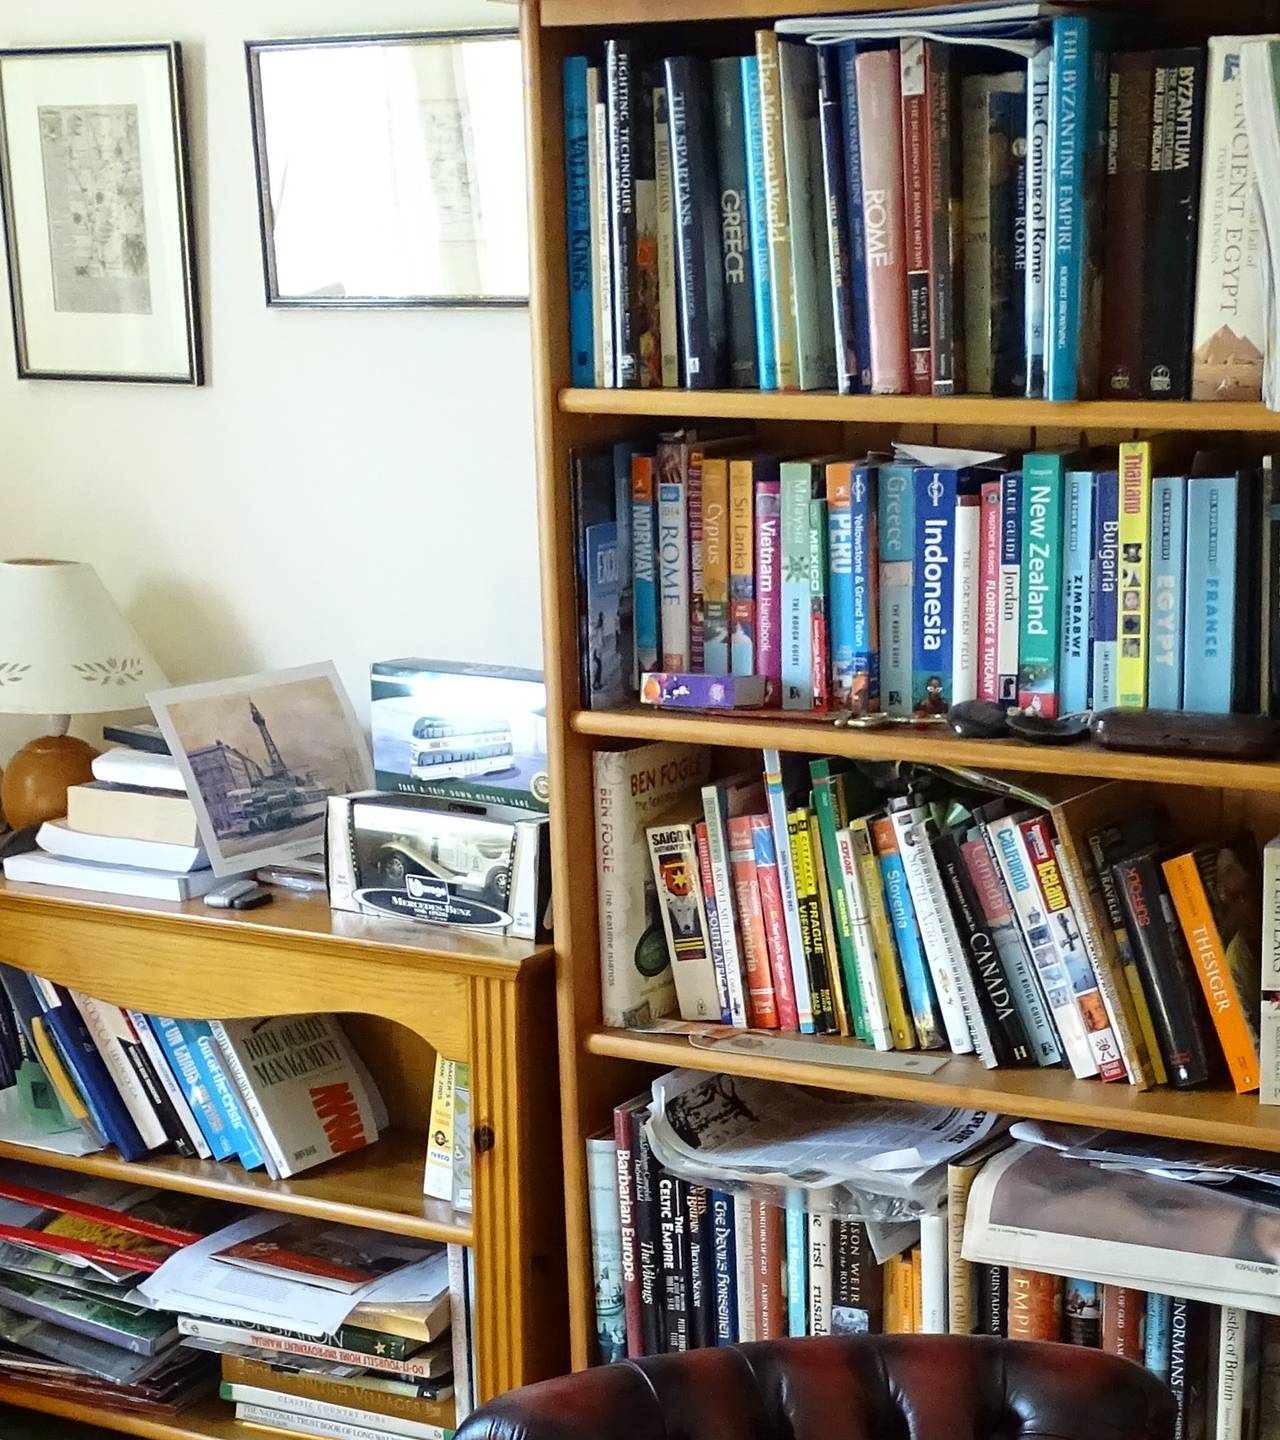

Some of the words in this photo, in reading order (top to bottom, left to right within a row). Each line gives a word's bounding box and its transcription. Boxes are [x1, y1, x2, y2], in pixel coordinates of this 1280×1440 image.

[1059, 70, 1077, 180] BYZANTINE
[1174, 66, 1196, 170] BYZANTIUM
[620, 127, 631, 214] TECHNIQUES
[676, 134, 693, 226] SPARTANS
[721, 189, 744, 284] GREECE
[865, 189, 889, 267] ROME
[1015, 217, 1027, 271] ROME
[1057, 185, 1075, 255] EMPIRE
[1219, 227, 1242, 317] EGYPT
[791, 478, 809, 544] Malaysia
[886, 475, 908, 551] Greece
[1006, 479, 1017, 515] BLUE
[1030, 486, 1050, 538] New
[633, 505, 651, 583] NORWAY
[705, 503, 721, 565] Cyprus
[734, 525, 748, 570] Lanka
[760, 519, 776, 593] Vietnam
[809, 529, 820, 592] MEXICO
[831, 512, 852, 574] PERU
[854, 513, 865, 573] Yellowstone
[1005, 520, 1016, 560] GUIDE
[1098, 520, 1119, 592] Bulgaria
[661, 525, 681, 607] ROME
[923, 519, 948, 651] Indonesia
[1027, 543, 1051, 635] Zealand
[854, 586, 865, 615] Grand
[985, 579, 997, 634] FLORENCE
[1003, 570, 1018, 621] Jordan
[1071, 575, 1083, 658] ZIMBABWE
[1155, 574, 1176, 667] EGYPT
[1204, 578, 1219, 658] FRANCE
[760, 597, 774, 652] Handbook
[983, 648, 996, 694] TUSCANY
[601, 823, 615, 873] FOGLE
[839, 840, 853, 876] EXPLORE
[887, 870, 909, 929] Slovenia
[972, 843, 1006, 912] Canada
[391, 896, 472, 918] MERCEDES-BENZ
[807, 901, 824, 955] PRAGUE
[968, 932, 1015, 1021] CANADA
[1190, 925, 1232, 1014] THESIGER
[430, 1152, 451, 1162] IVECO
[617, 1149, 633, 1224] Barbarian
[659, 1179, 673, 1218] CELTIC
[640, 1240, 654, 1262] The
[661, 1222, 675, 1270] EMPIRE
[674, 1216, 685, 1234] THE
[620, 1227, 636, 1282] Europe
[850, 1263, 860, 1303] WEIR
[641, 1263, 656, 1305] Vikings
[250, 1333, 283, 1350] MANUAL
[283, 1340, 337, 1361] IMPROVEMENT
[338, 1350, 362, 1364] HOME
[363, 1354, 425, 1376] DO-IT-YOURSELF
[1170, 1303, 1187, 1386] NORMANS
[277, 1395, 313, 1409] CLASSIC
[315, 1399, 357, 1417] COUNTRY
[359, 1411, 386, 1423] PUBS
[1223, 1360, 1238, 1401] Britain
[296, 1414, 320, 1428] TRUST
[319, 1419, 339, 1433] BOOK
[350, 1427, 375, 1440] LONG
